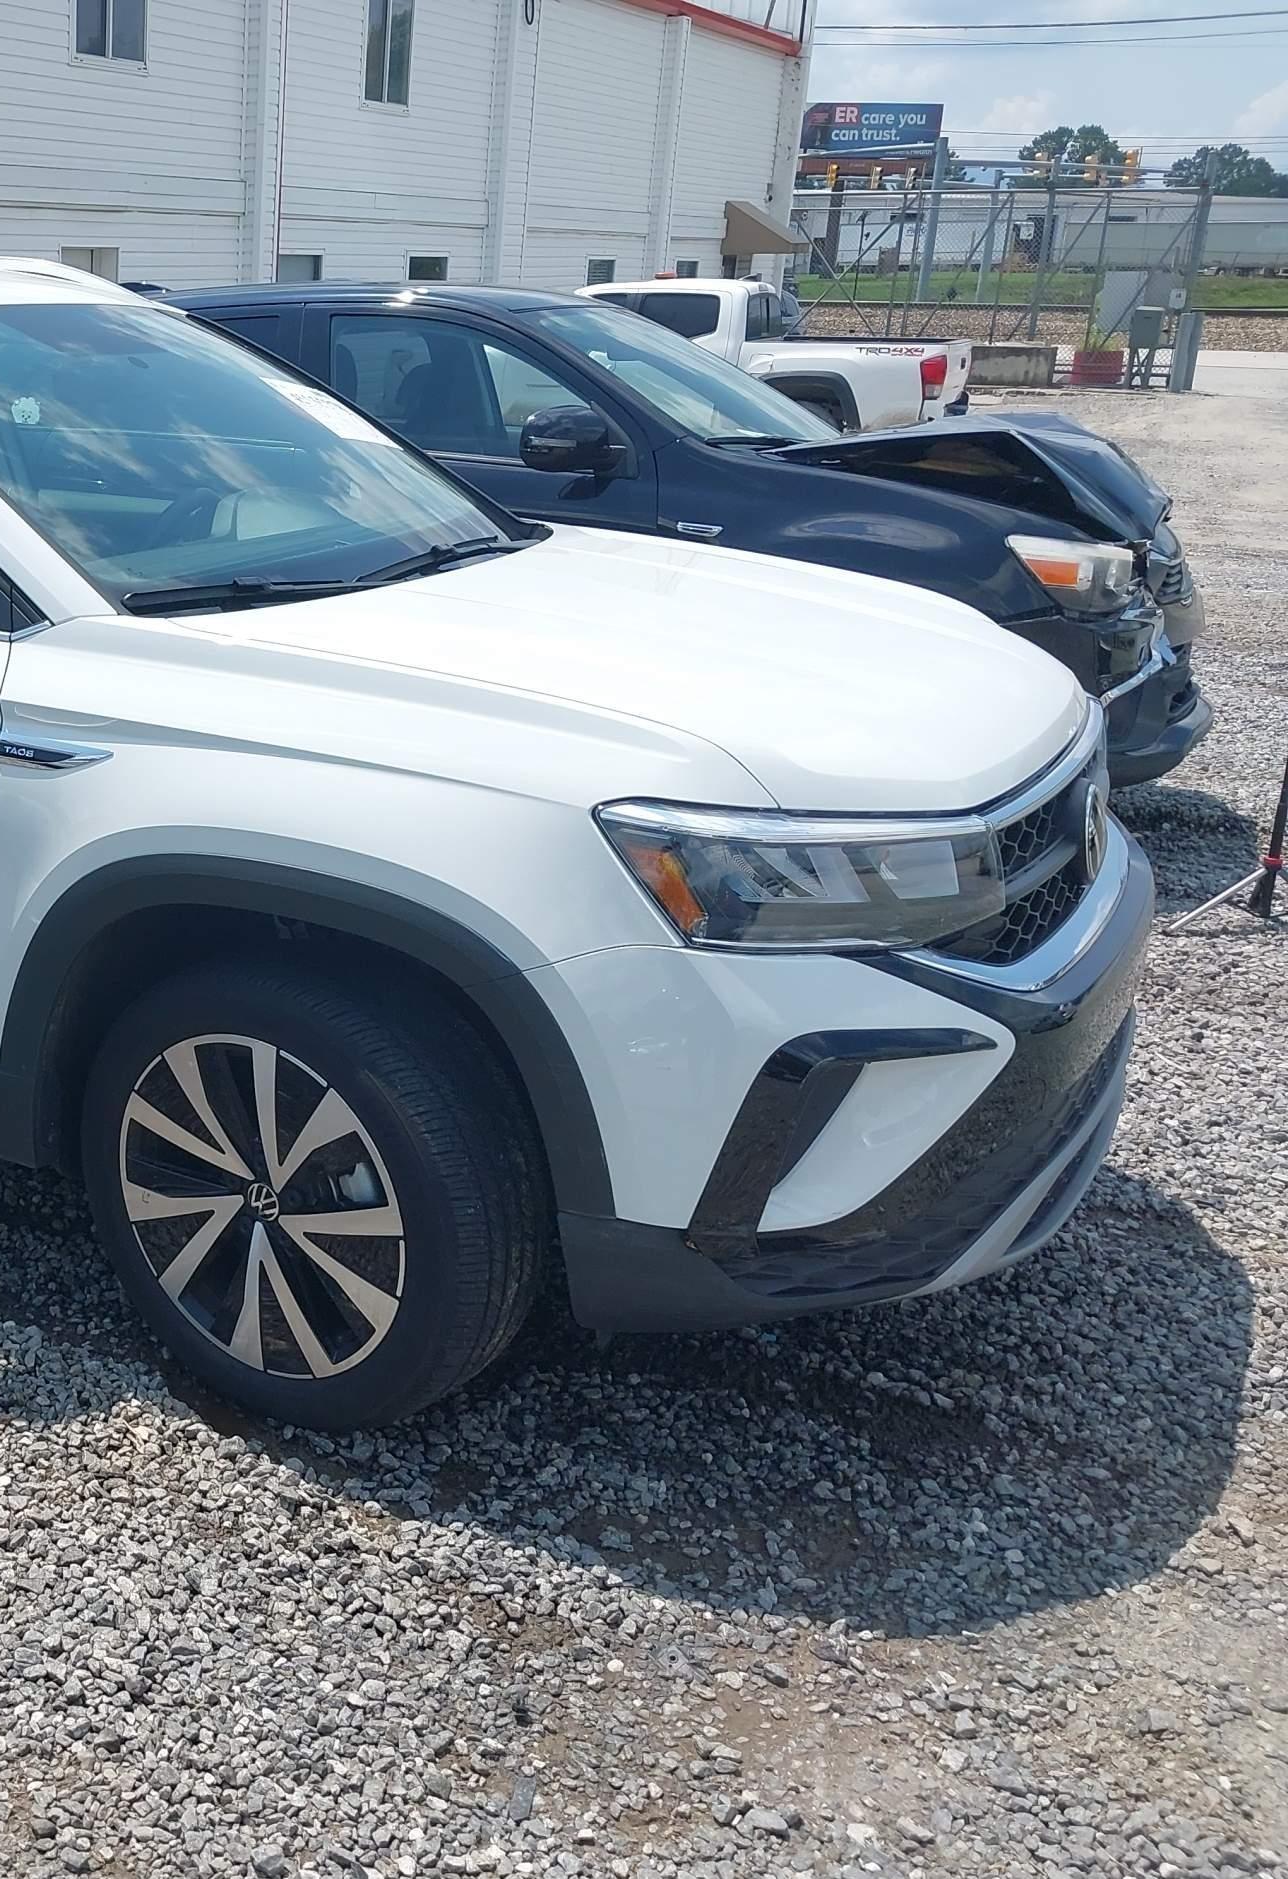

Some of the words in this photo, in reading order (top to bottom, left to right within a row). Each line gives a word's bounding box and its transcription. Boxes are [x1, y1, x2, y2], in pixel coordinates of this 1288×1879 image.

[834, 106, 858, 123] ER
[861, 113, 895, 125] care
[898, 113, 926, 128] you
[831, 129, 858, 141] can
[861, 127, 900, 141] trust.
[3, 745, 35, 759] TAOS
